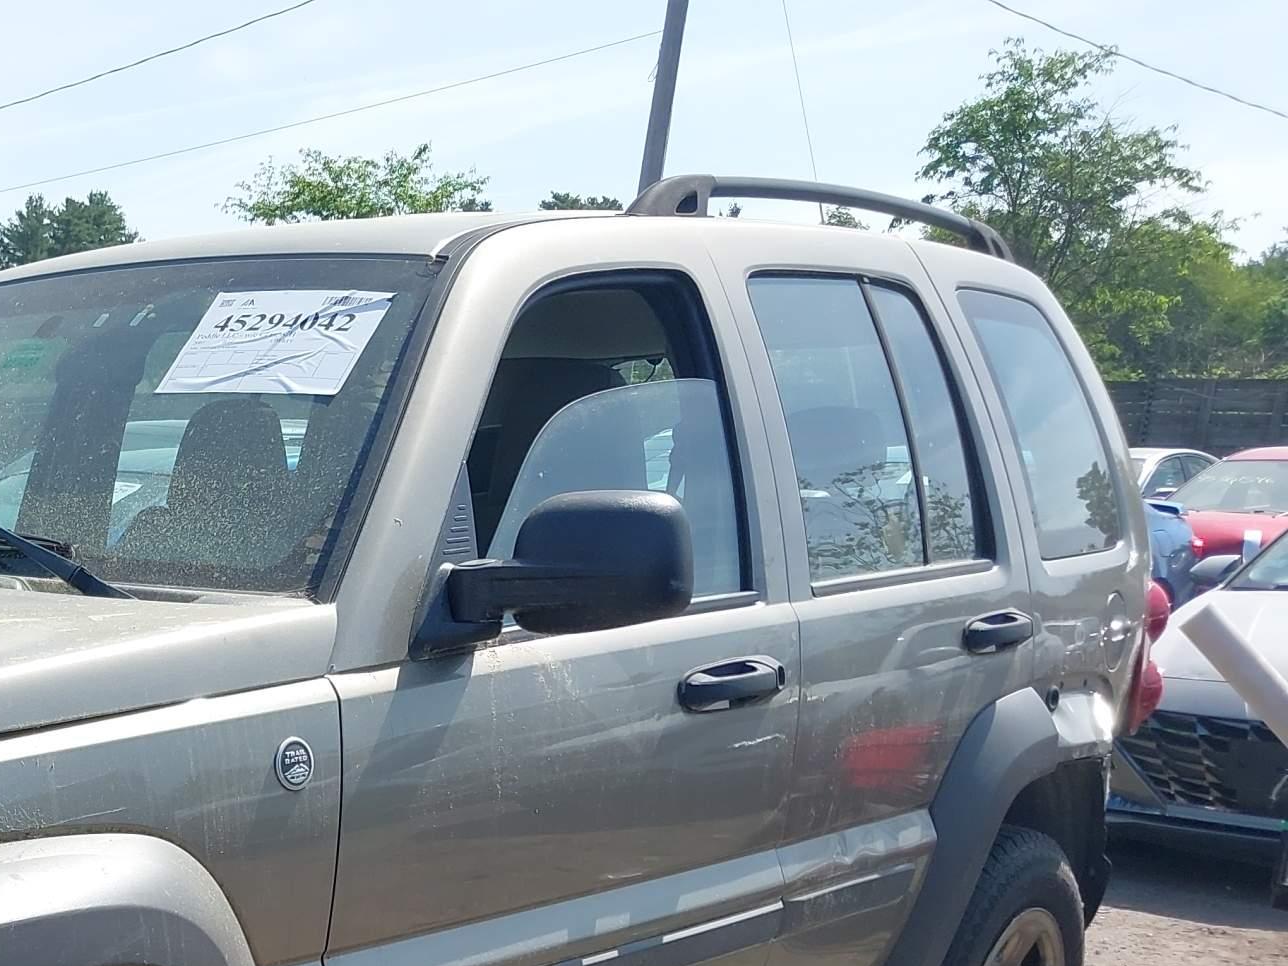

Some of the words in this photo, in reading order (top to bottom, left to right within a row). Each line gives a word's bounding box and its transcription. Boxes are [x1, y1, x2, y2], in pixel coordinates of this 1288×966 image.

[214, 312, 357, 333] 45294042
[284, 748, 307, 759] TRAIL
[284, 755, 309, 765] RATED
